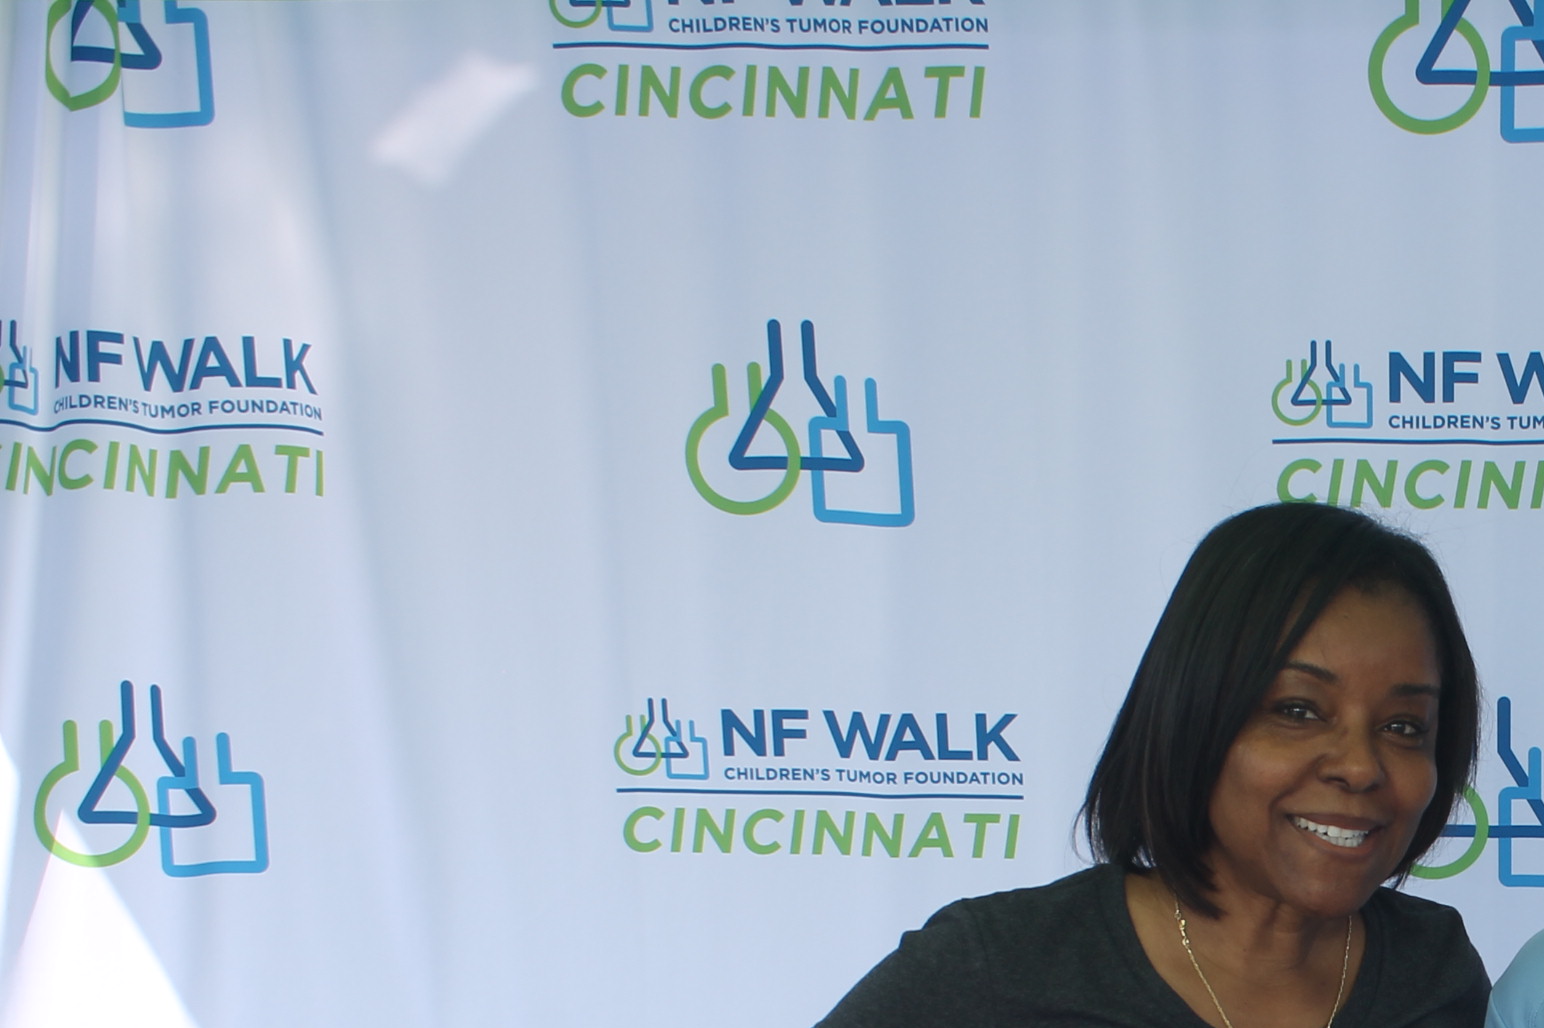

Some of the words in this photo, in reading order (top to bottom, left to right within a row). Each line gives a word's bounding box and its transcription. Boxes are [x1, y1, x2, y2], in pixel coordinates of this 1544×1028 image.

[669, 18, 780, 33] CHILDREN'S
[788, 18, 852, 34] TUMOR
[858, 18, 989, 34] FOUNDATION
[561, 63, 985, 120] CINCINNATI
[56, 330, 124, 388] NF
[133, 336, 318, 395] WALK
[1389, 352, 1481, 403] NF
[54, 394, 139, 414] CHILDREN'S
[143, 402, 202, 418] TUMOR
[209, 400, 322, 420] FOUNDATION
[1389, 415, 1500, 430] CHILDREN'S
[0, 439, 324, 499] INCINNATI
[721, 709, 809, 757] NF
[823, 710, 1021, 761] WALK
[724, 767, 830, 782] CHILDREN'S
[837, 769, 897, 785] TUMOR
[904, 771, 1024, 786] FOUNDATION
[623, 806, 1020, 859] CINCINNATI
